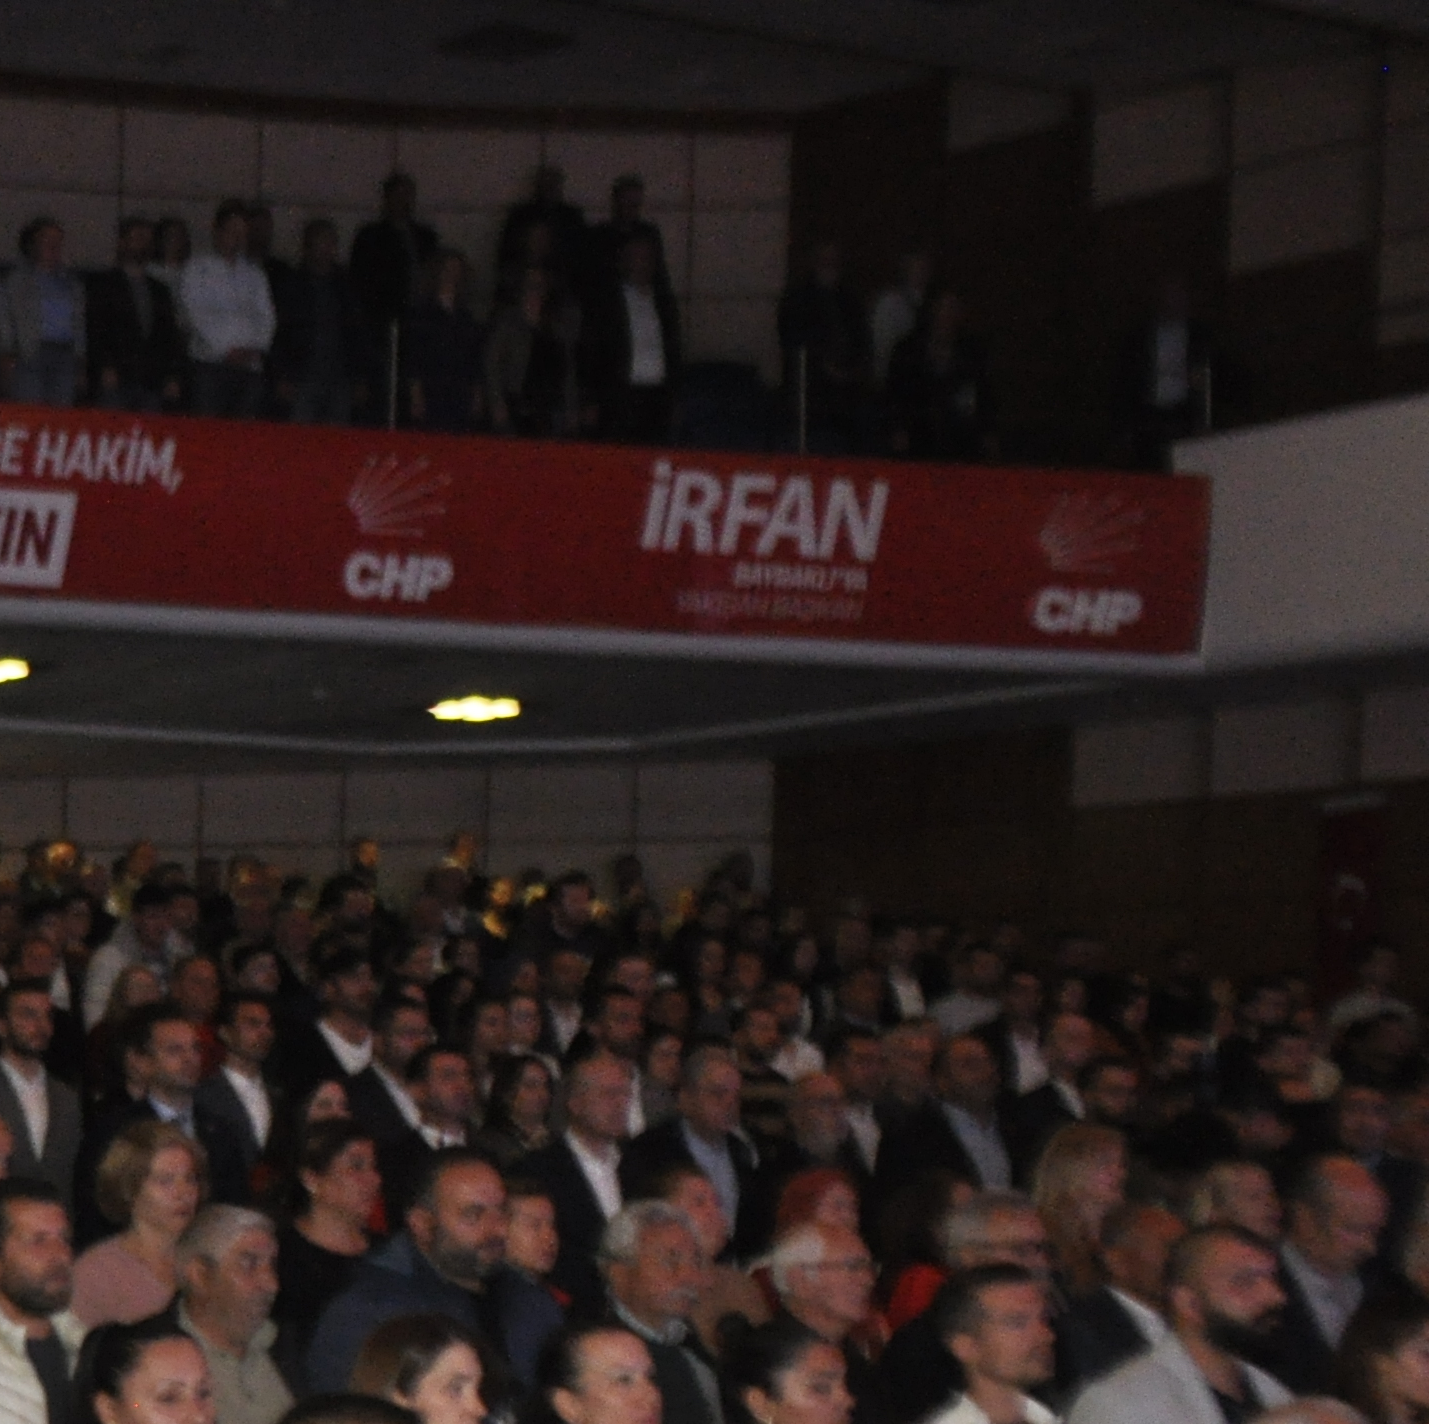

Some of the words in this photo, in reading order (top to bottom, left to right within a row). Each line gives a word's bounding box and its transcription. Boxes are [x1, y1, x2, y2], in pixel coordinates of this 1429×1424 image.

[34, 427, 184, 496] HAKİM,
[344, 551, 455, 603] CHP
[1033, 587, 1143, 636] CHP
